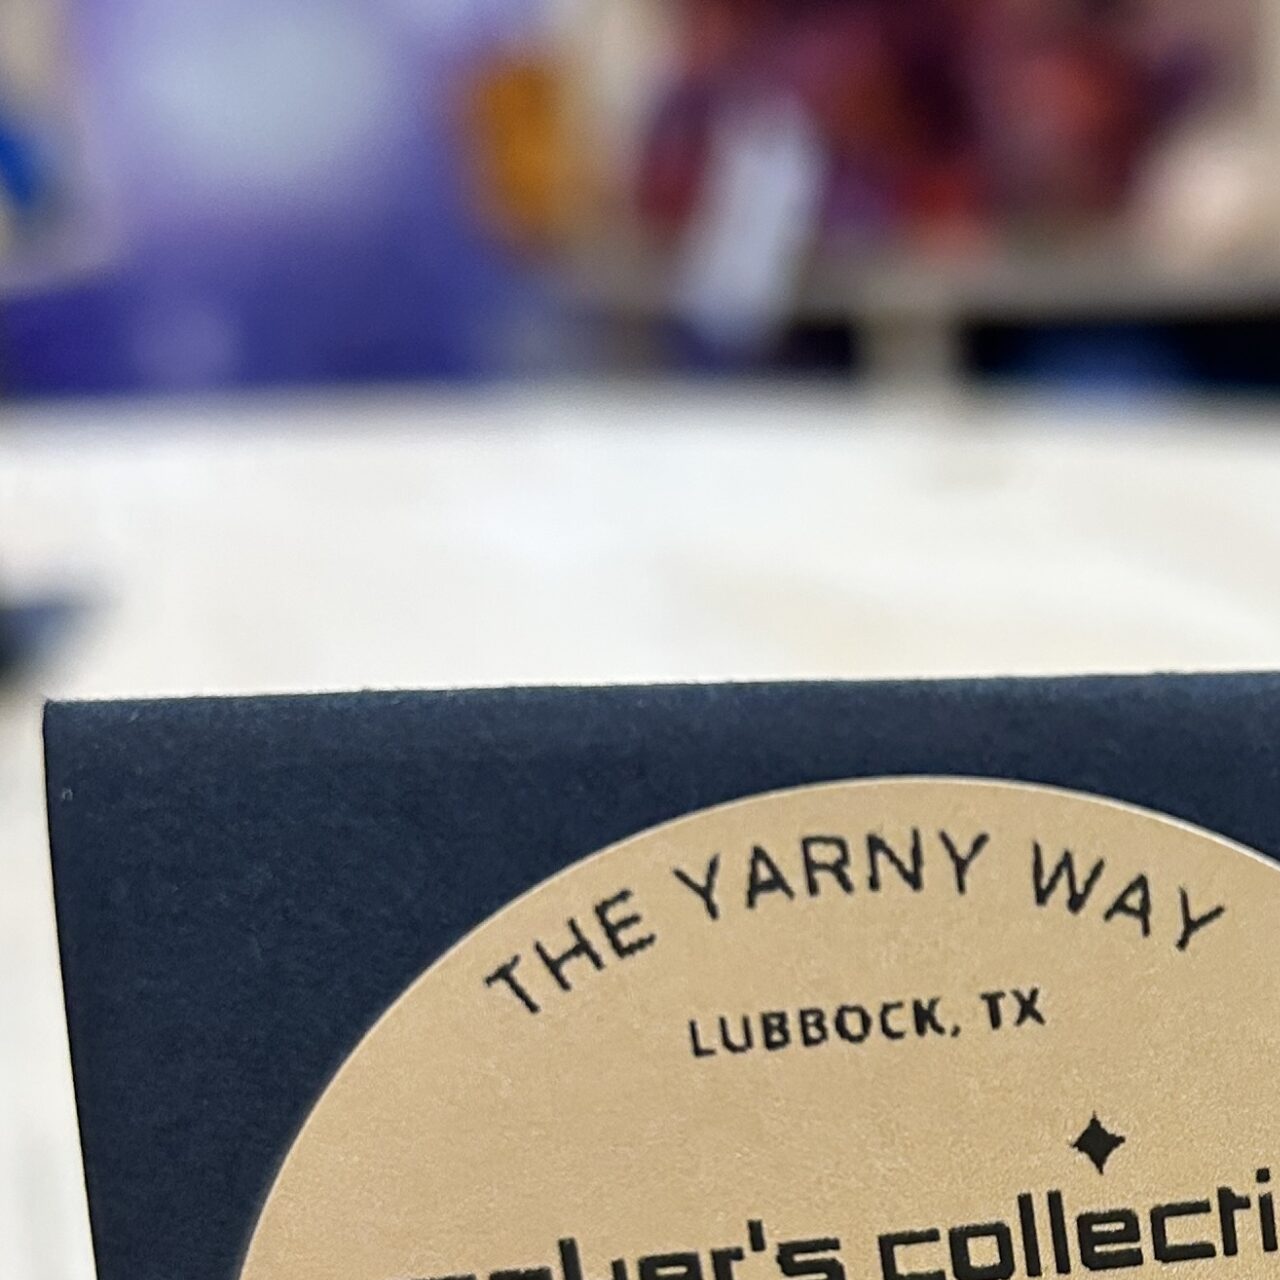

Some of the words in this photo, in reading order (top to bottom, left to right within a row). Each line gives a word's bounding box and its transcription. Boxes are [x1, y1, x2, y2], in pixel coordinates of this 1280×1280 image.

[482, 887, 658, 1016] THE
[671, 827, 991, 923] YARNY
[1030, 840, 1227, 953] WAY
[687, 996, 963, 1060] LUBBOCK,
[977, 985, 1048, 1033] TX
